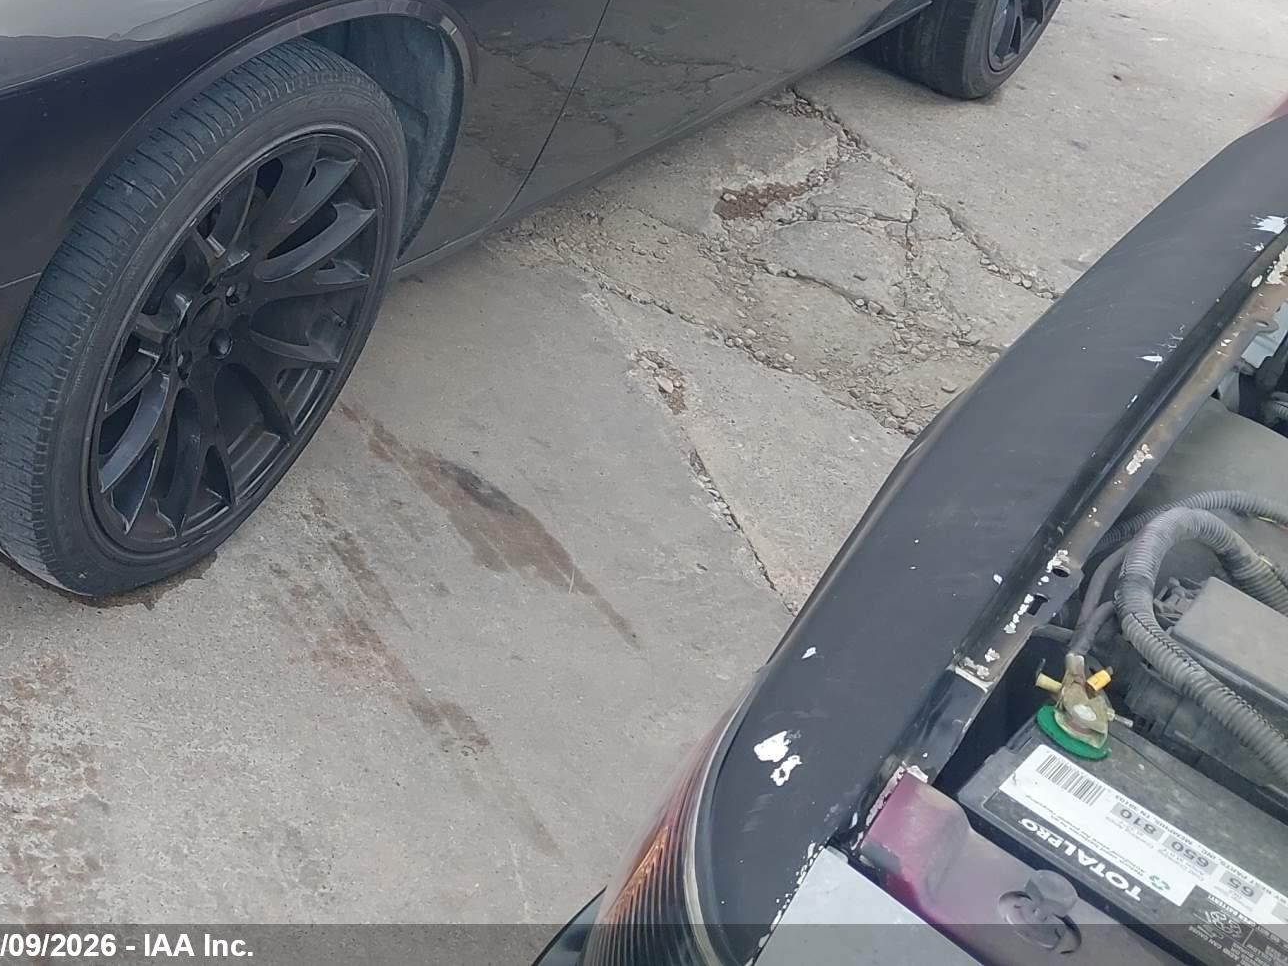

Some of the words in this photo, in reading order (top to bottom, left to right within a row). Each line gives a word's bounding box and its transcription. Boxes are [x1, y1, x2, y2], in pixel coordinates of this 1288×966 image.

[1118, 807, 1158, 836] 810
[1019, 818, 1141, 901] TOTALPRO
[1169, 839, 1211, 870] 650
[1227, 877, 1255, 899] 65
